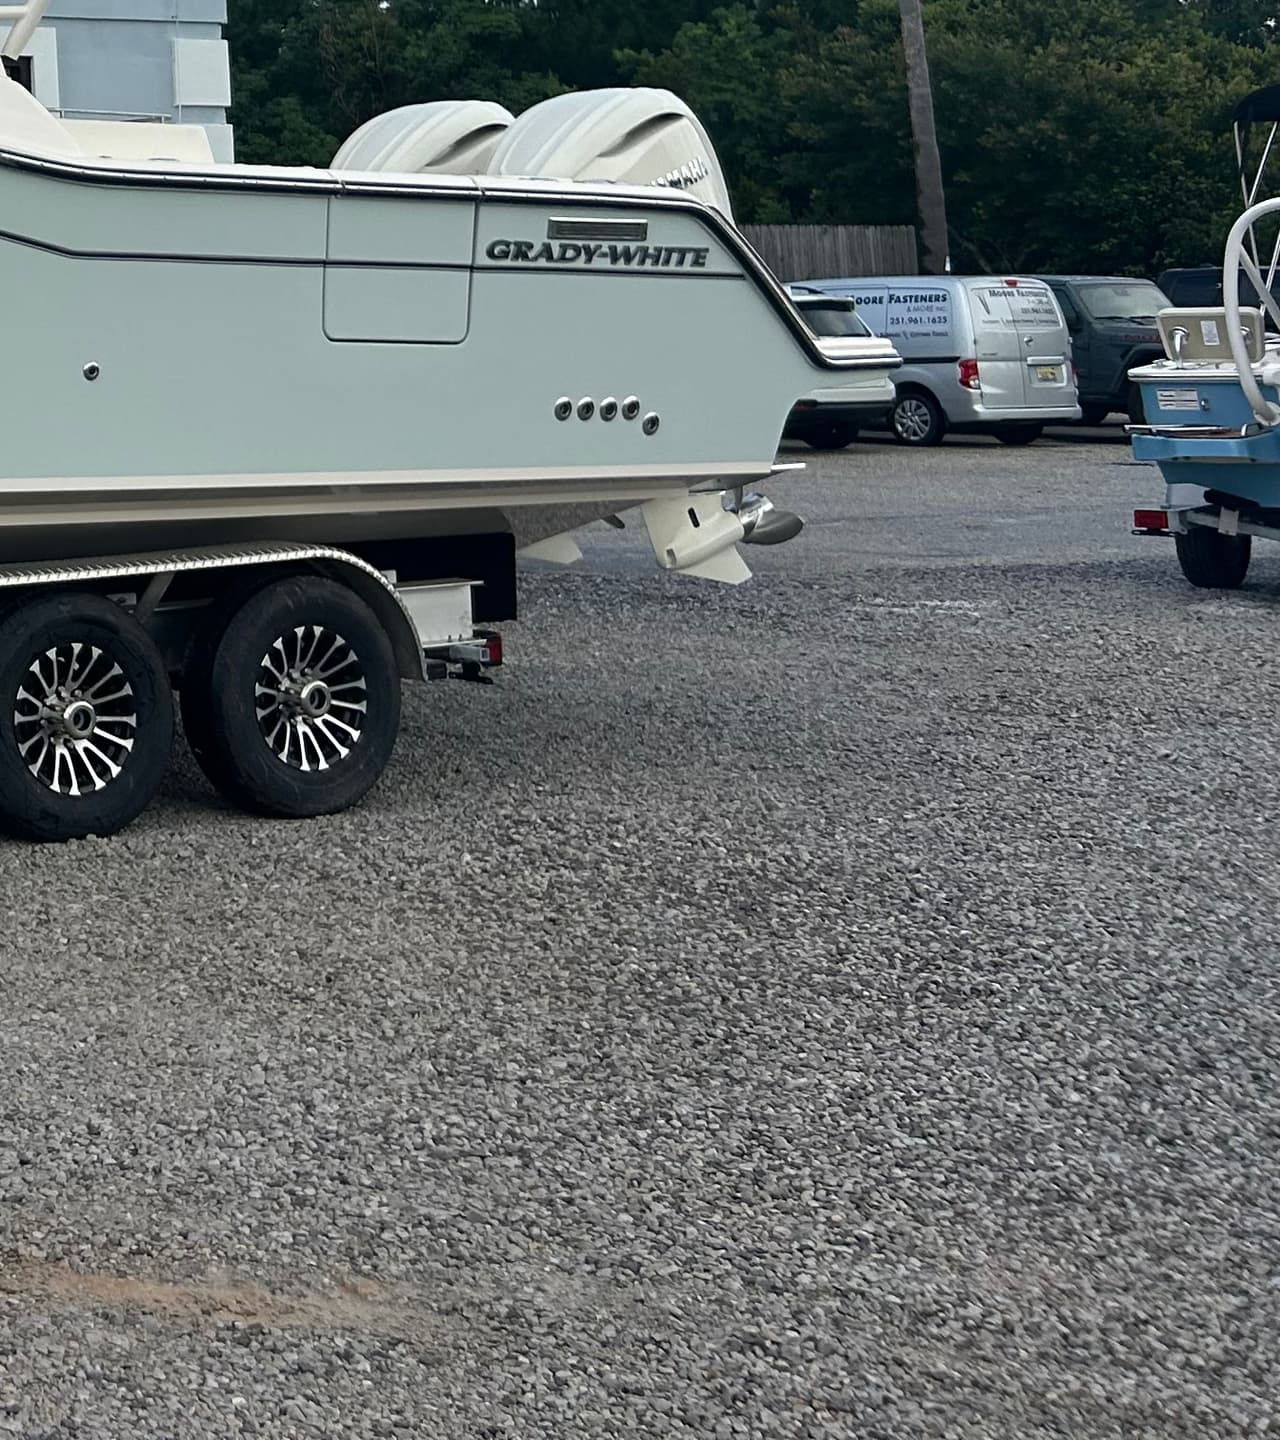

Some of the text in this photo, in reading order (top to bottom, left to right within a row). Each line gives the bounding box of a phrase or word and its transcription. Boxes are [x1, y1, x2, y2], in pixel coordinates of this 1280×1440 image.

[485, 239, 710, 268] GRADY-WHITE
[846, 293, 948, 305] OORE FASTENERS
